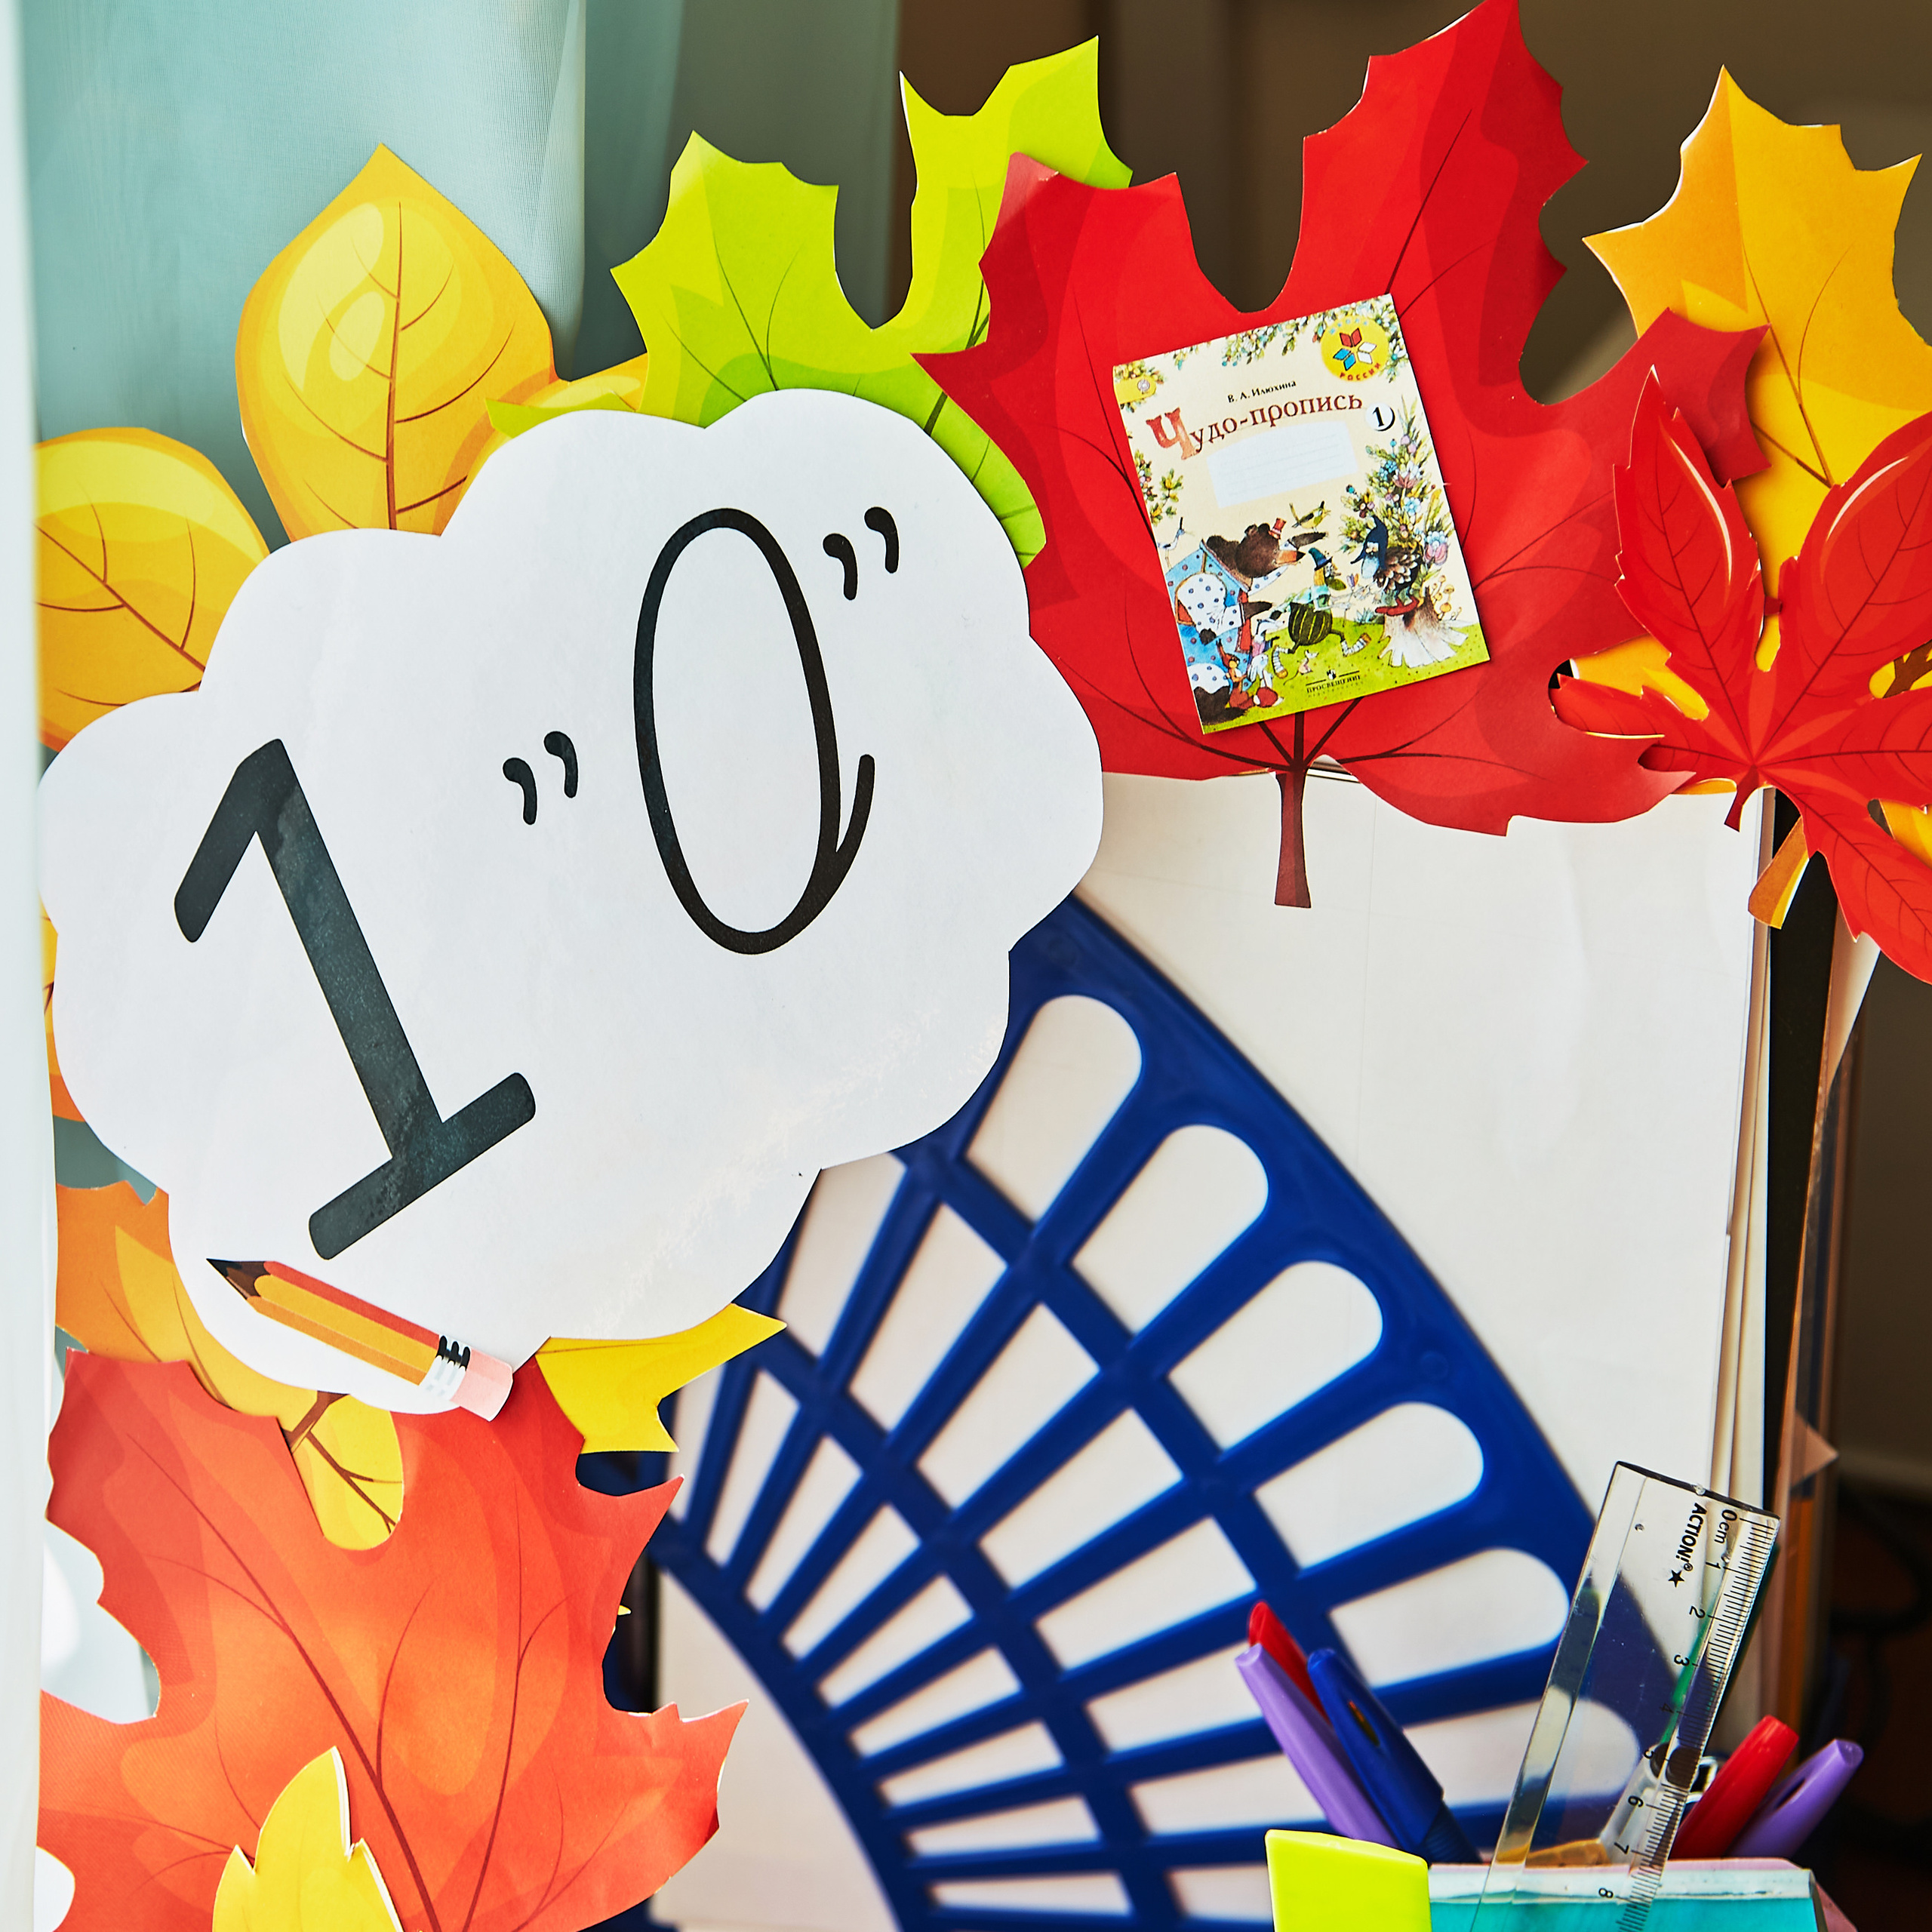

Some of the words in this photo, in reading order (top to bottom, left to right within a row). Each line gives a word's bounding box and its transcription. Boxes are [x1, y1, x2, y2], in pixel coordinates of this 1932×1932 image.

[1340, 362, 1381, 381] РОССИИ
[1227, 394, 1238, 404] В.
[1240, 392, 1251, 400] А.
[1251, 380, 1297, 397] Илюхина
[1372, 407, 1386, 428] 1
[1146, 394, 1363, 460] Чудо-пропись
[174, 738, 536, 1260] 1
[1689, 1605, 1706, 1619] 2
[1673, 1654, 1690, 1667] 3
[1659, 1703, 1675, 1714] 4
[1627, 1795, 1644, 1807] 6
[1614, 1841, 1629, 1855] 7
[1598, 1887, 1614, 1899] 8
